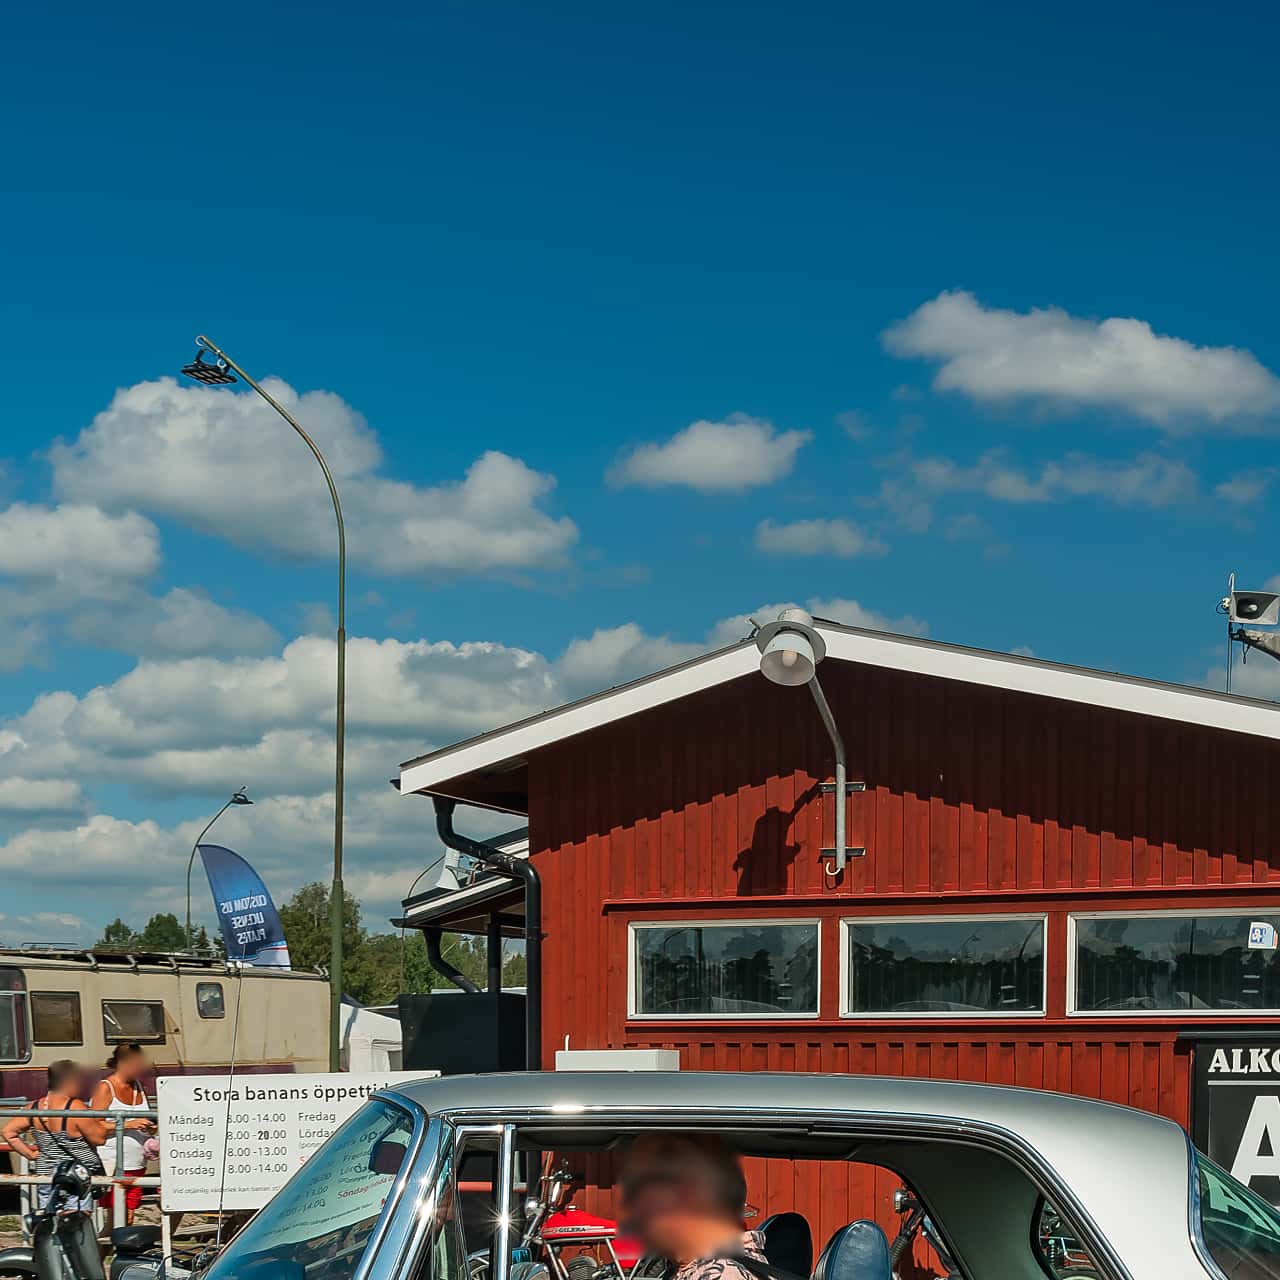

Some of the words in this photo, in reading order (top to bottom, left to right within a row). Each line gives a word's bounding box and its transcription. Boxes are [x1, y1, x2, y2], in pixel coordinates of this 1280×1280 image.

[193, 1087, 240, 1102] Stora
[245, 1085, 308, 1101] banans
[298, 1111, 336, 1124] Fredag
[168, 1131, 206, 1144] Tisdag
[169, 1148, 213, 1160] Onsdag
[170, 1165, 216, 1177] Torsdag
